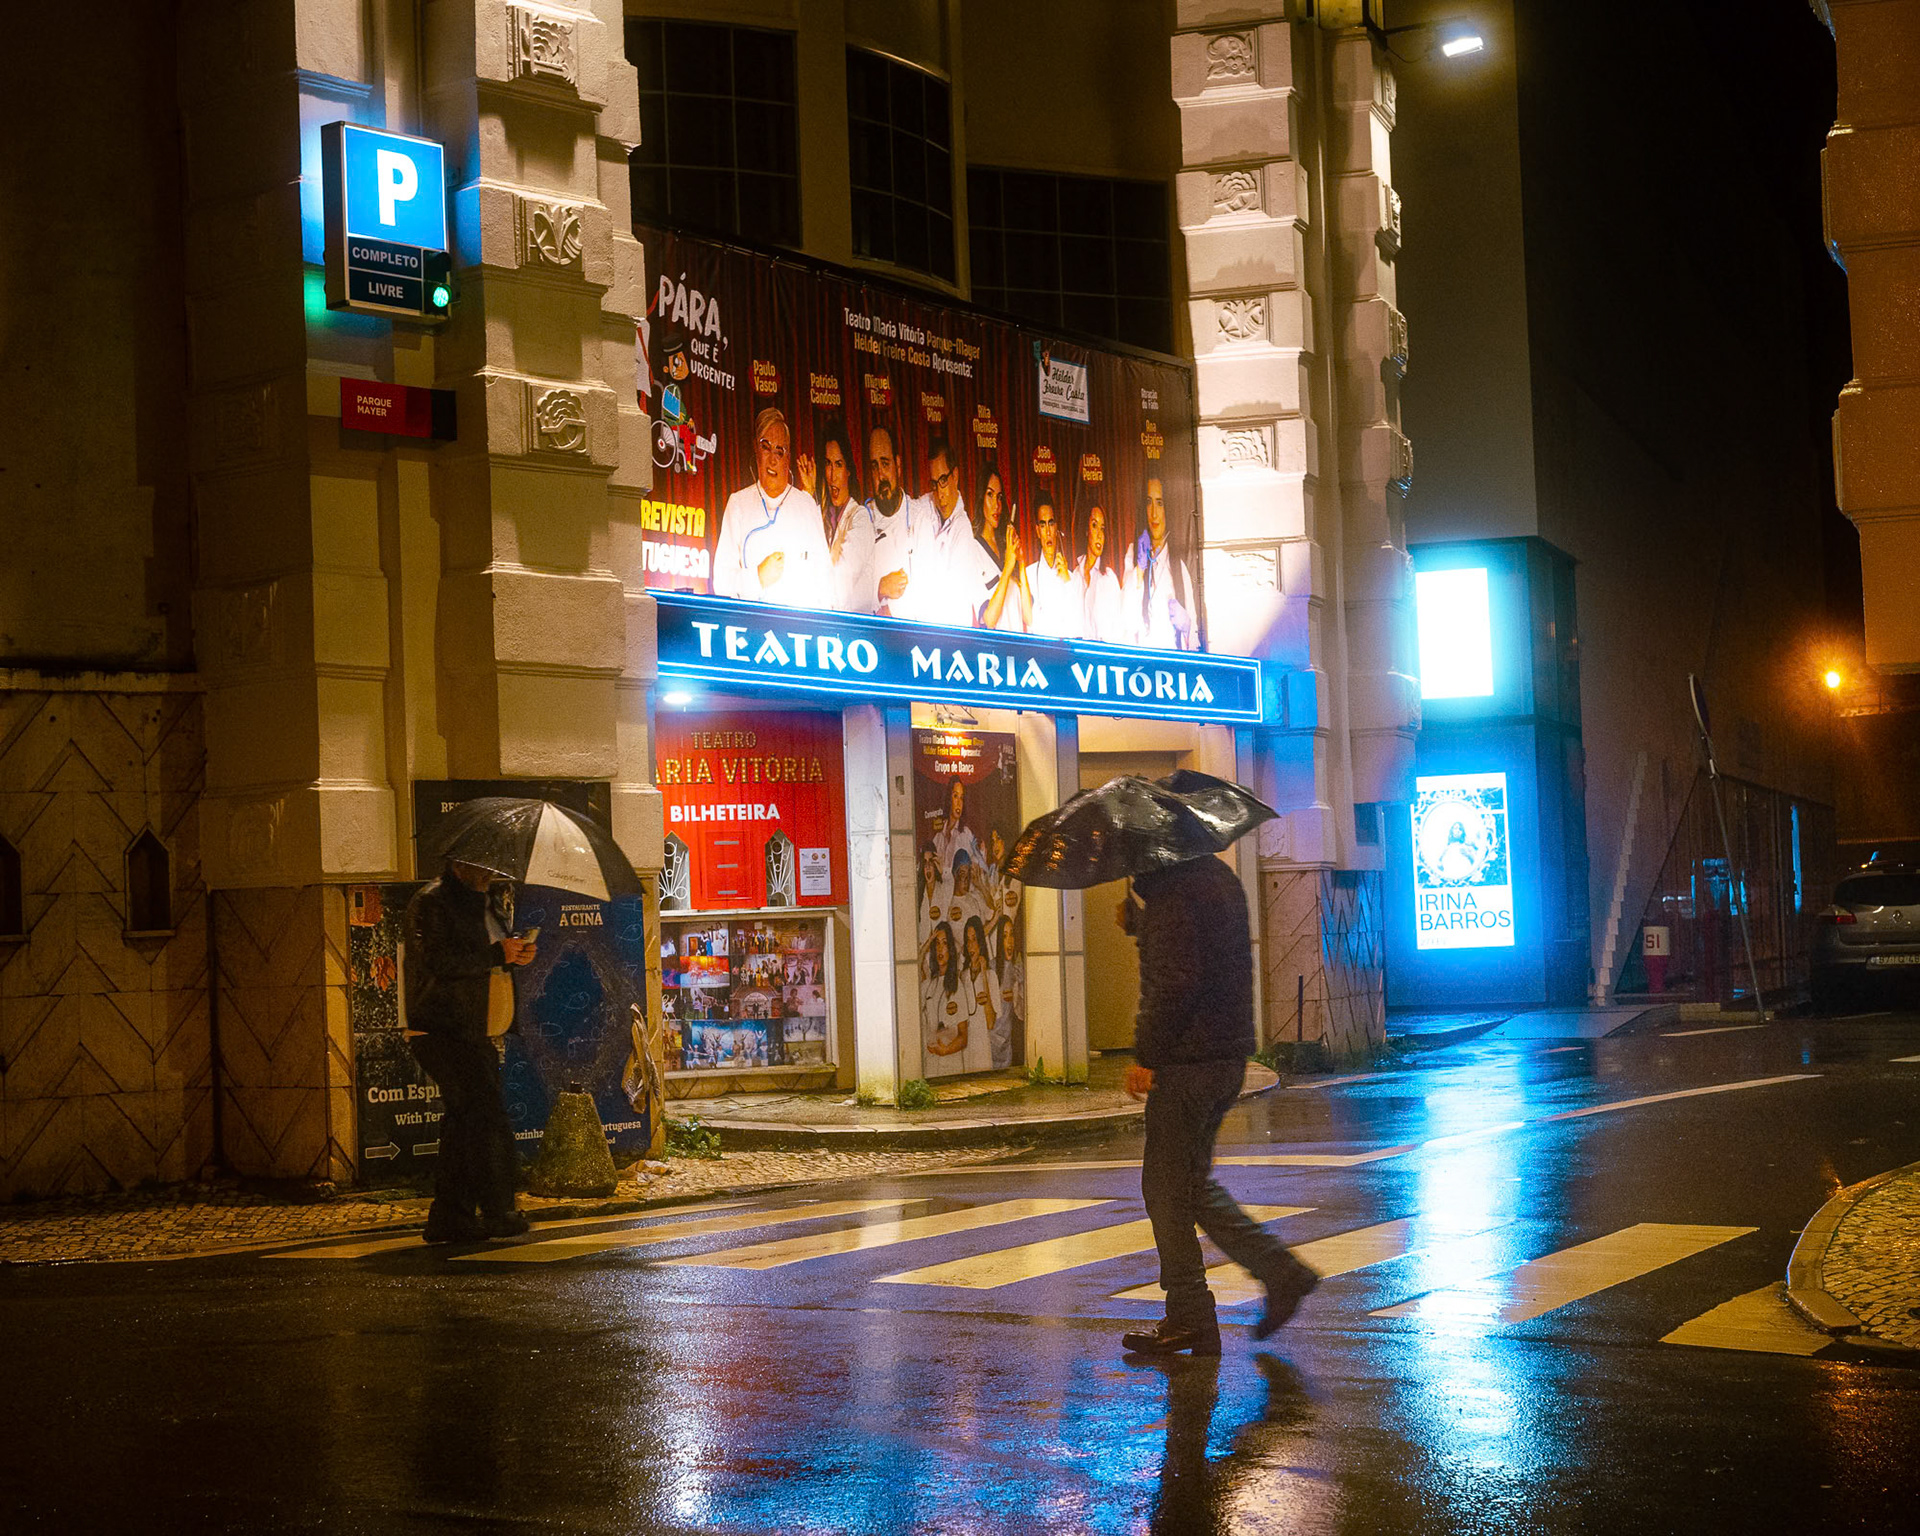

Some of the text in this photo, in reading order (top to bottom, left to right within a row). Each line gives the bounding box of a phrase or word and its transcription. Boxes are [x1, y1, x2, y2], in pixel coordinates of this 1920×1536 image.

[377, 149, 418, 226] P
[352, 246, 419, 268] COMPLETO
[368, 281, 404, 299] LIVRE
[659, 272, 728, 351] PÁRA,
[844, 307, 871, 331] Teatro
[872, 316, 897, 339] Maria
[898, 322, 925, 346] Vitória
[691, 338, 719, 363] QUE É
[854, 332, 973, 379] Hélder Freire Costa Apresenta:
[690, 359, 735, 391] URGENTE!
[753, 360, 776, 377] Paulo
[754, 376, 777, 393] Vasco
[864, 373, 890, 391] Miguel
[871, 389, 886, 405] Dias
[921, 391, 944, 408] Renato
[1066, 384, 1085, 401] Costa
[357, 395, 392, 408] PARQUE
[357, 405, 387, 417] MAYER
[926, 407, 941, 422] Pino
[977, 404, 991, 419] Rita
[972, 418, 998, 434] Mendes
[1146, 419, 1157, 433] Ana
[976, 433, 997, 449] Nunes
[1140, 432, 1164, 446] Catarina
[1037, 445, 1051, 459] João
[1033, 459, 1057, 474] Gouveia
[1082, 467, 1103, 481] Pereira
[641, 499, 706, 538] REVISTA
[691, 621, 1214, 704] TEATRO MARIA VITÓRIA
[691, 731, 757, 749] TEATRO
[722, 753, 826, 784] VITÓRIA
[934, 760, 974, 776] Grupo de Dança
[670, 803, 781, 823] BILHETEIRA
[561, 904, 601, 912] RESTAURANTE
[1419, 892, 1478, 912] IRINA
[559, 911, 604, 927] A GINA
[1420, 909, 1511, 931] BARROS
[368, 1086, 405, 1104] Com
[395, 1111, 423, 1126] With
[513, 1128, 544, 1141] ozinha
